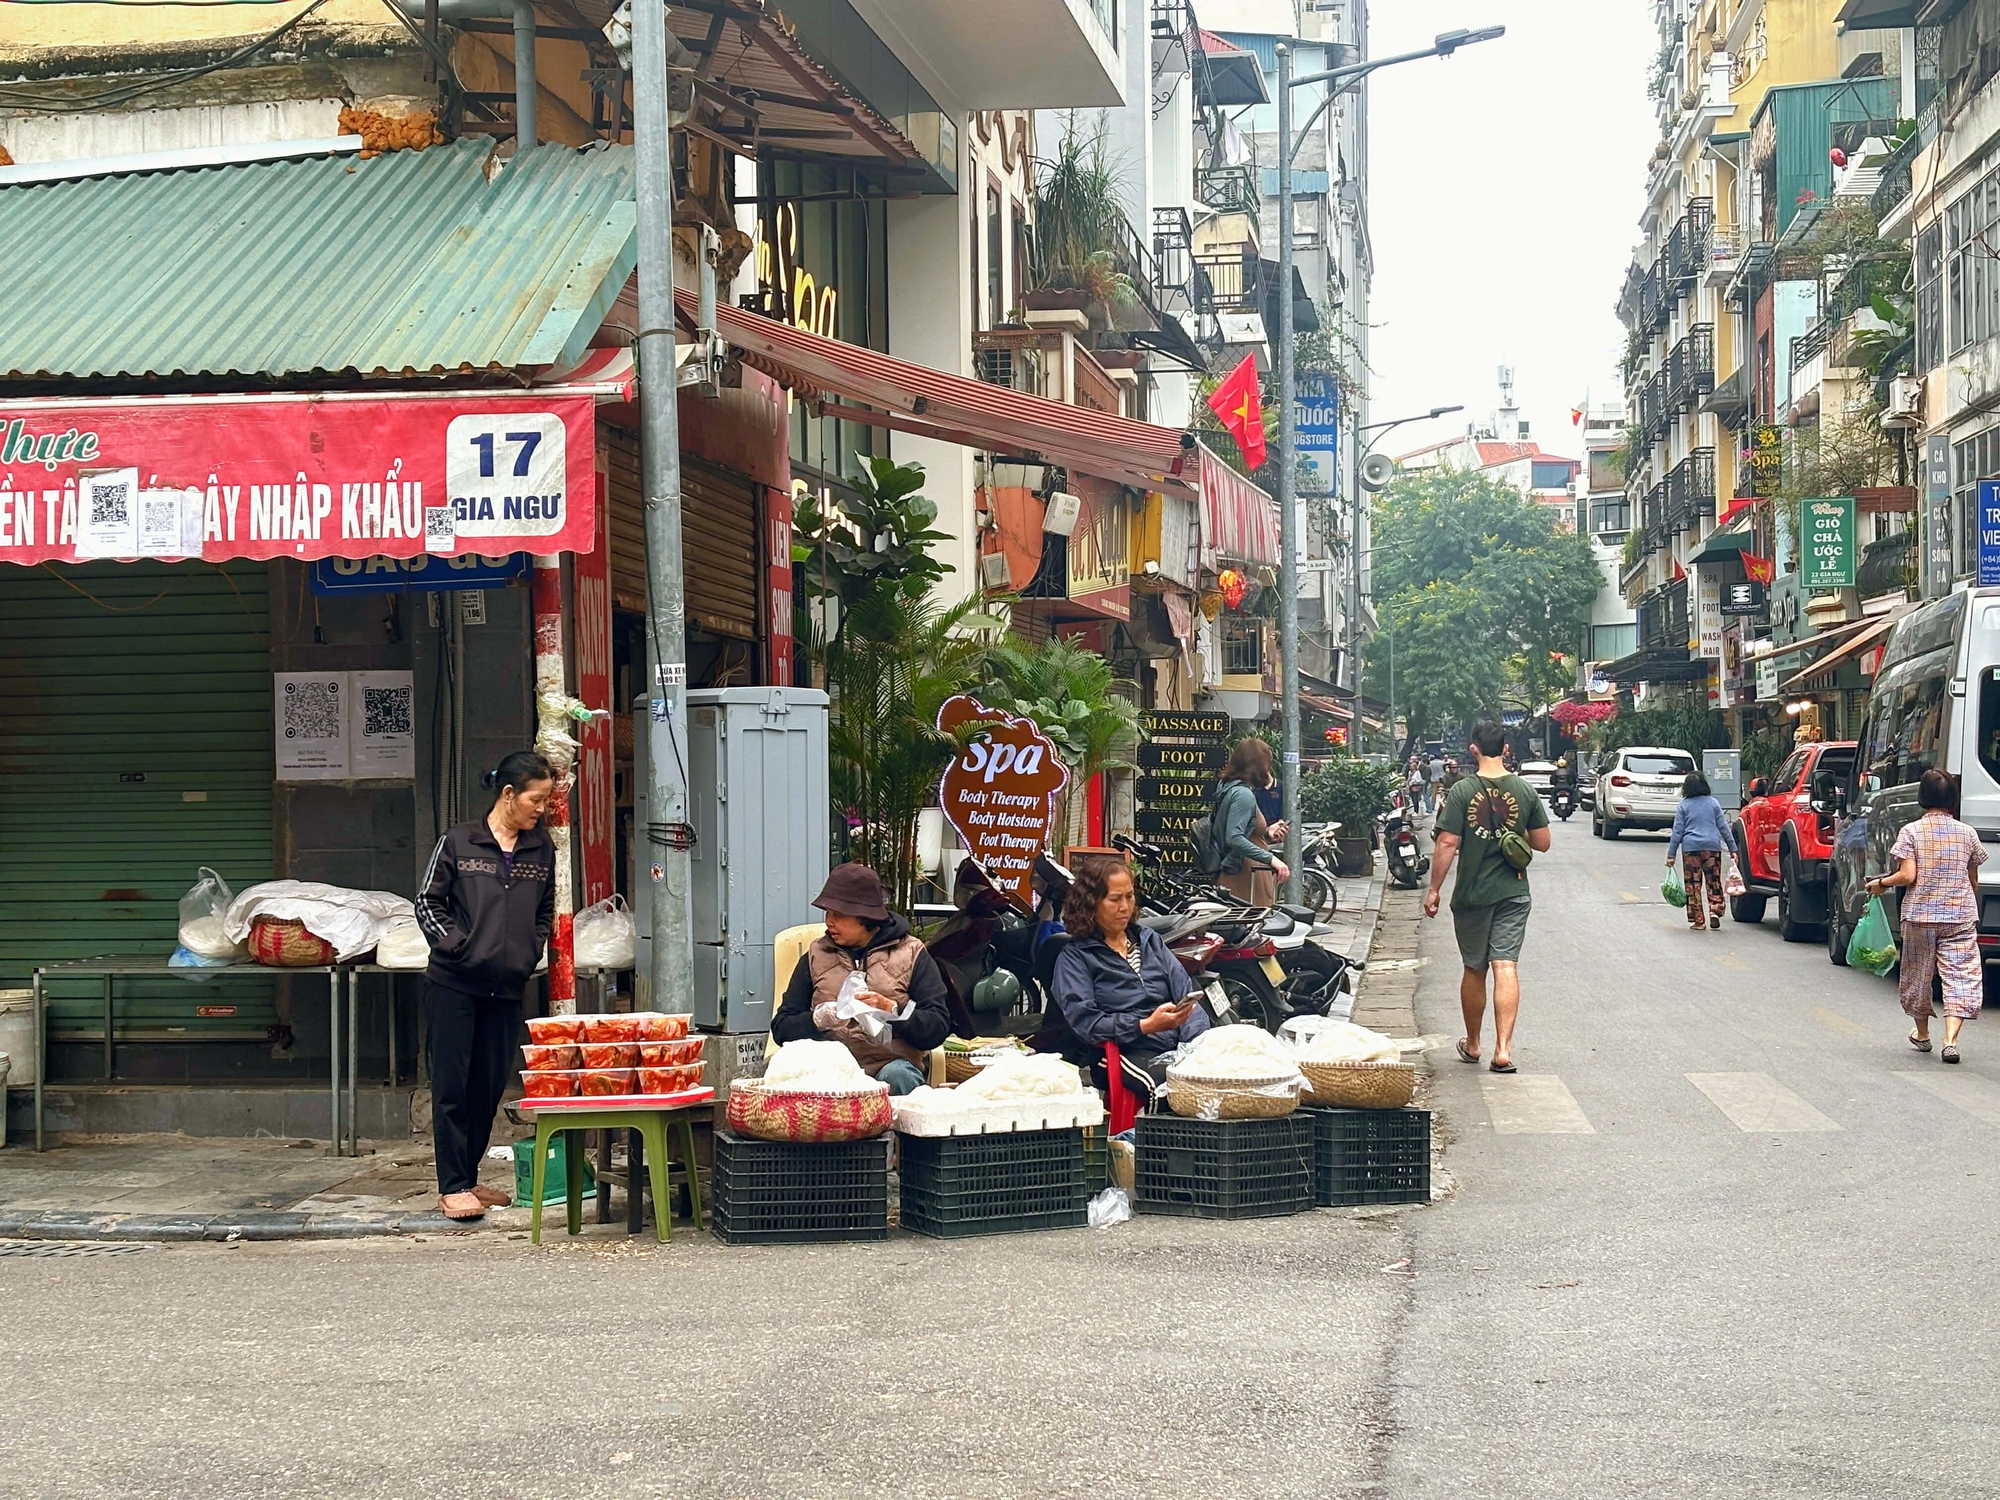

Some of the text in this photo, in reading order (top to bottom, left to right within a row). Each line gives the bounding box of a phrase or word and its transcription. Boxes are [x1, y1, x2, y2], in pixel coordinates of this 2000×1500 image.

[471, 432, 542, 477] 17
[1932, 470, 1947, 484] KHO
[187, 474, 241, 542] ÂY
[250, 468, 332, 553] NHẬP
[342, 457, 422, 539] KHẨU
[451, 493, 562, 521] GIA NGƯ
[1815, 516, 1840, 528] GIÒ
[771, 510, 790, 570] LIÊN
[1813, 529, 1843, 542] CHẢ
[1814, 544, 1843, 556] ƯỚC
[1820, 556, 1837, 570] LỄ
[1703, 575, 1718, 583] SPA
[772, 587, 791, 637] SINH
[1702, 632, 1721, 641] WASH
[1703, 647, 1720, 655] HAIR
[1145, 718, 1223, 732] MASSAGE
[962, 734, 1043, 783] Spa
[1160, 751, 1206, 764] FOOT
[1159, 784, 1205, 797] BODY
[958, 789, 1040, 810] Body Therapy
[1486, 788, 1499, 797] TO
[1502, 792, 1519, 827] SOUTH
[969, 811, 1044, 828] Body Hotstone
[979, 832, 1038, 852] Foot Therapy
[457, 859, 497, 874] adidas
[983, 854, 1002, 868] Foot
